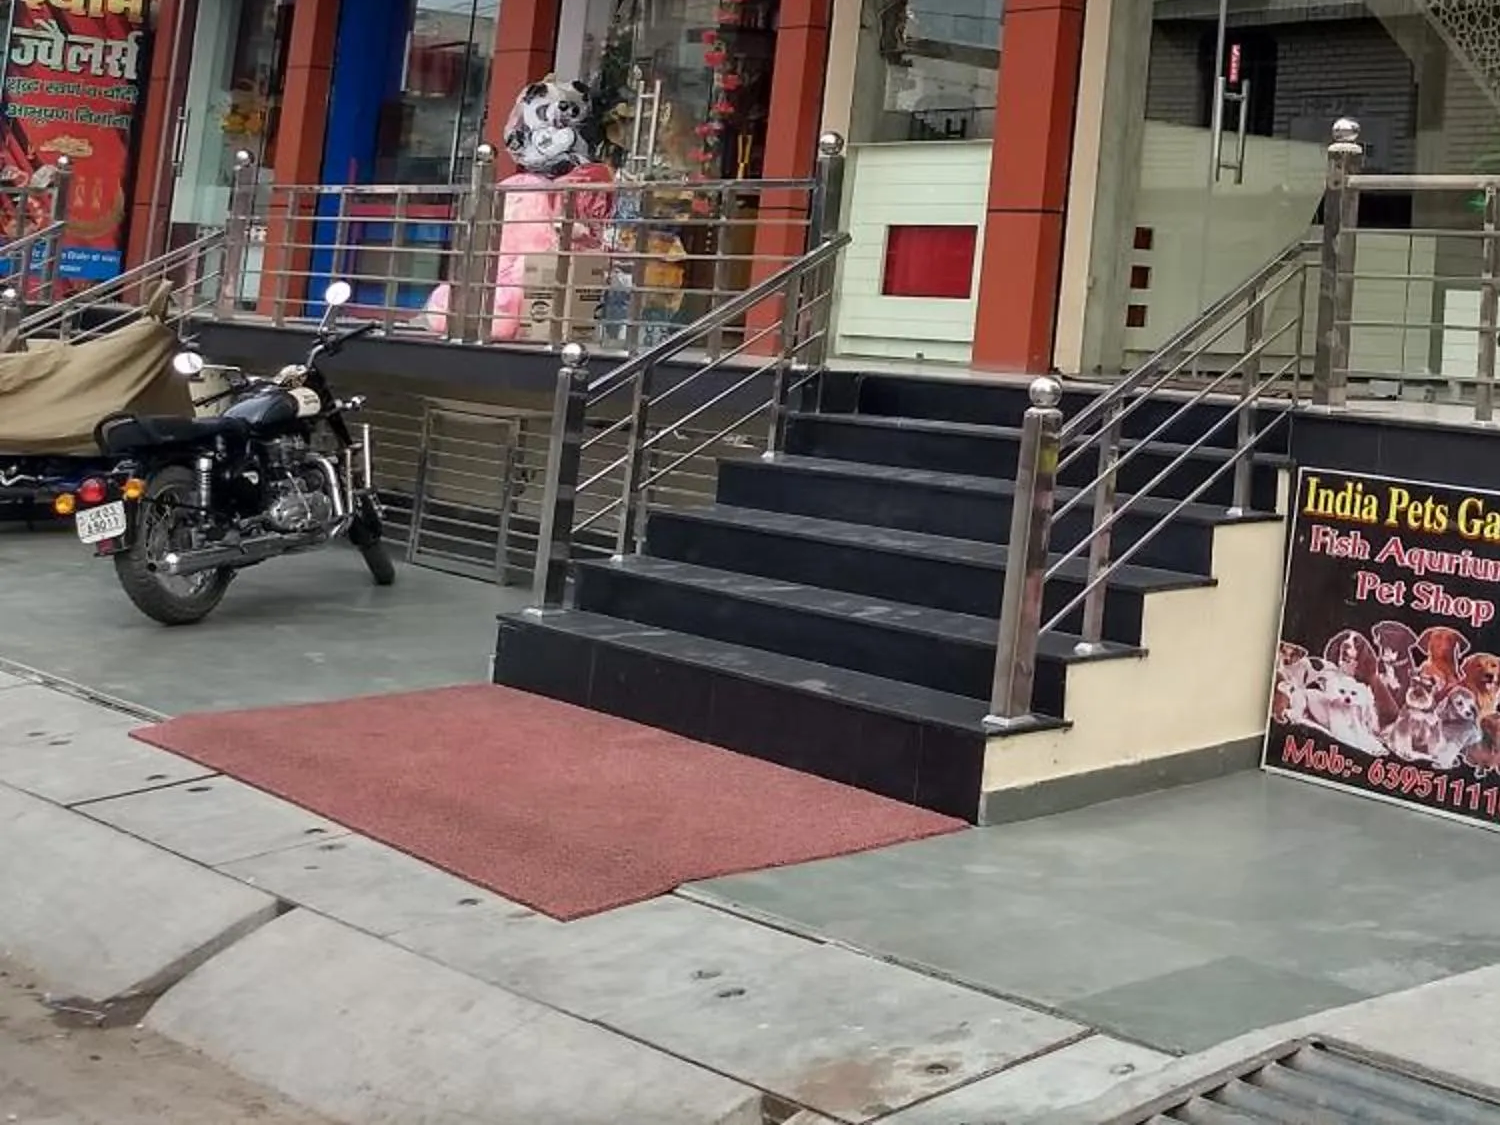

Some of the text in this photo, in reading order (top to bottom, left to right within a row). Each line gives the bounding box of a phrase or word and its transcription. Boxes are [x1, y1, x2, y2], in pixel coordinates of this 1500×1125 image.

[1303, 477, 1379, 524] India
[1385, 487, 1450, 534] Pets
[1308, 525, 1371, 561] Fish
[1355, 571, 1496, 627] Pet Shop
